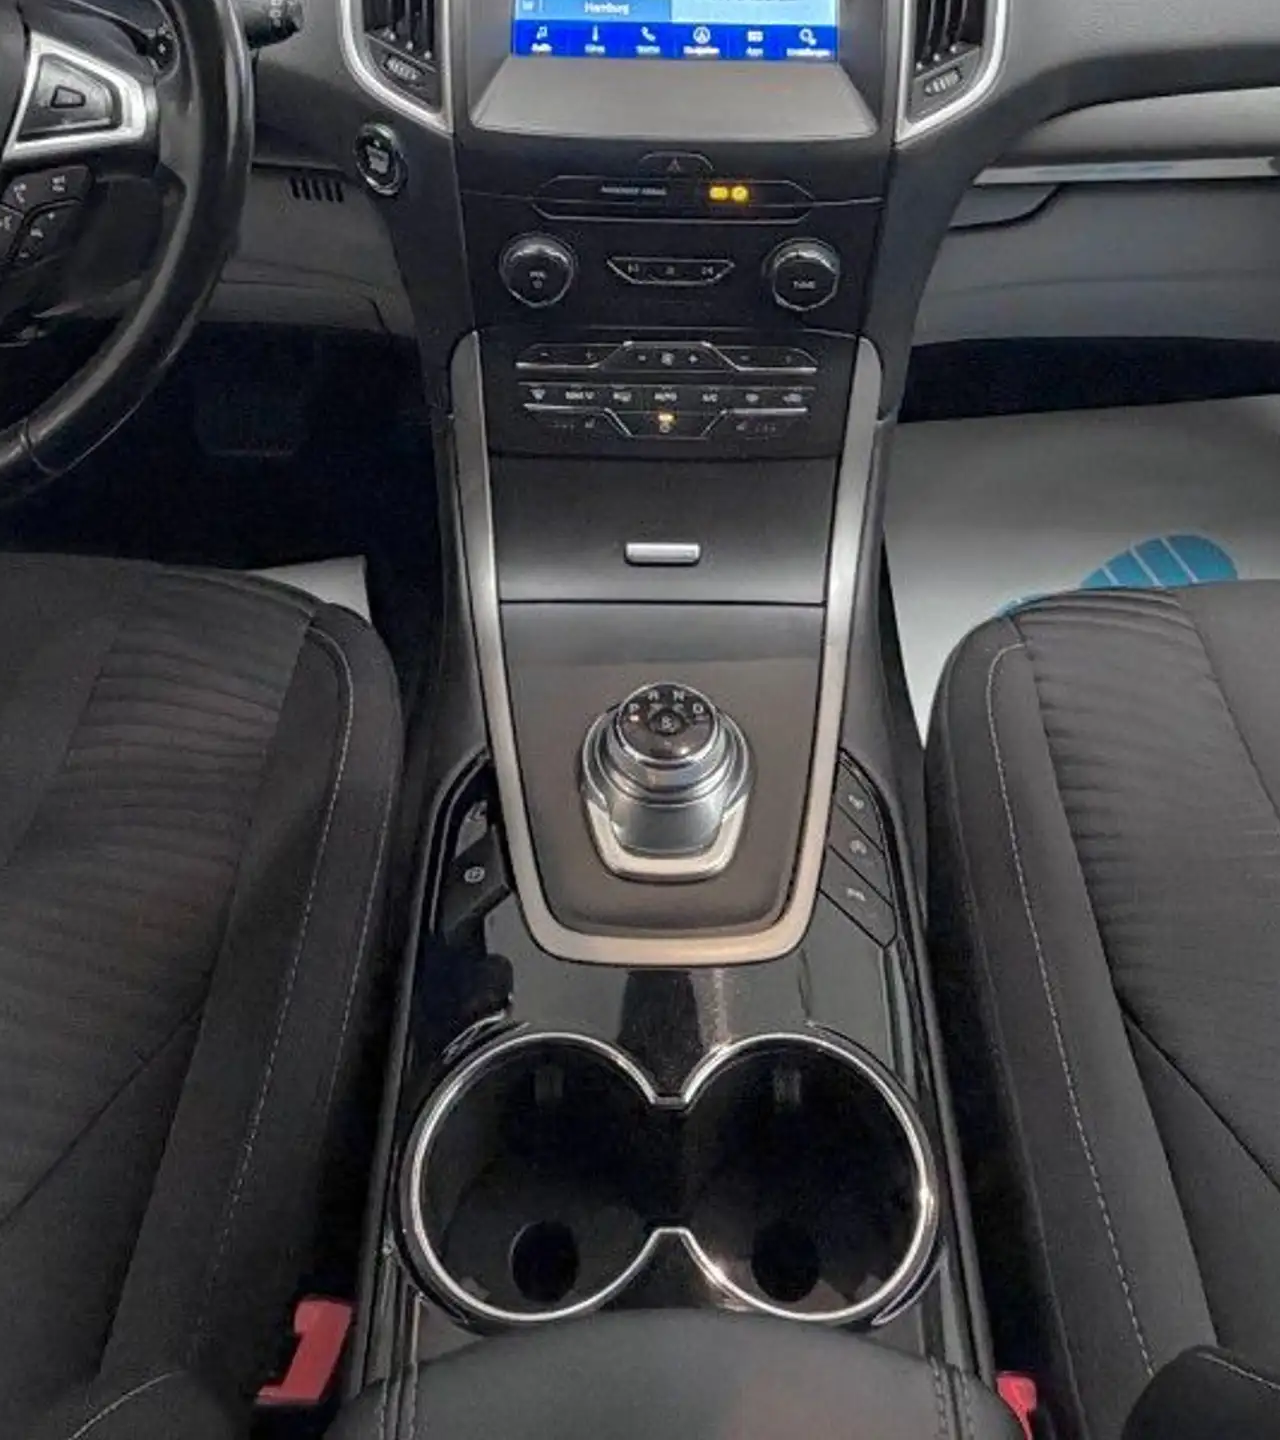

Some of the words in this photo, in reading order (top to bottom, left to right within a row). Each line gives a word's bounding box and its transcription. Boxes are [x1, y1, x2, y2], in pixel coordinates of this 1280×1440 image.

[584, 1, 630, 15] Hamburg
[628, 703, 639, 713] P
[672, 690, 686, 700] N
[692, 703, 704, 713] D
